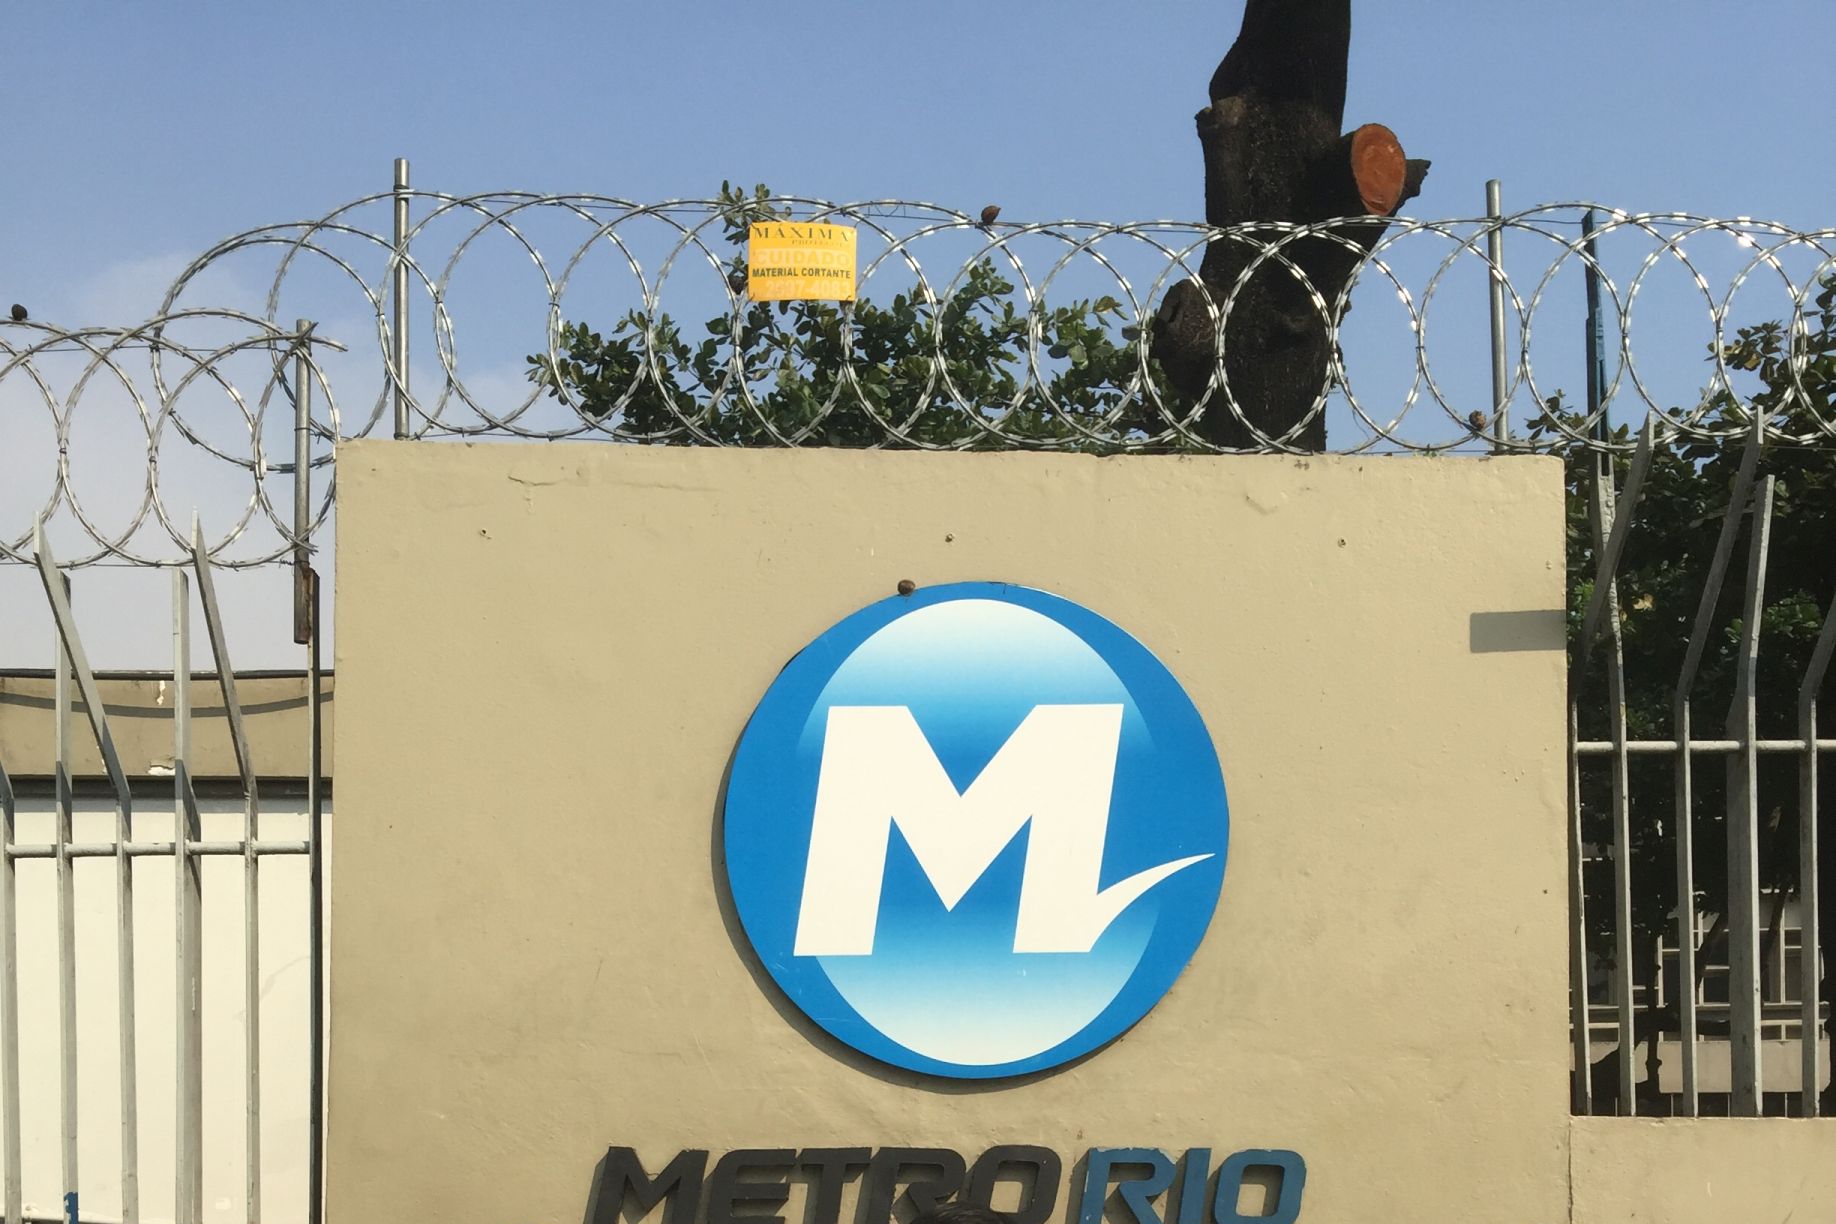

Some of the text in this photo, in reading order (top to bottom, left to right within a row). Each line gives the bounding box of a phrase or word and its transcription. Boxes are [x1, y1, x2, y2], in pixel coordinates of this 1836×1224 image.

[755, 250, 851, 267] CUIDADO
[752, 267, 851, 279] MATERIAL CORTANTE
